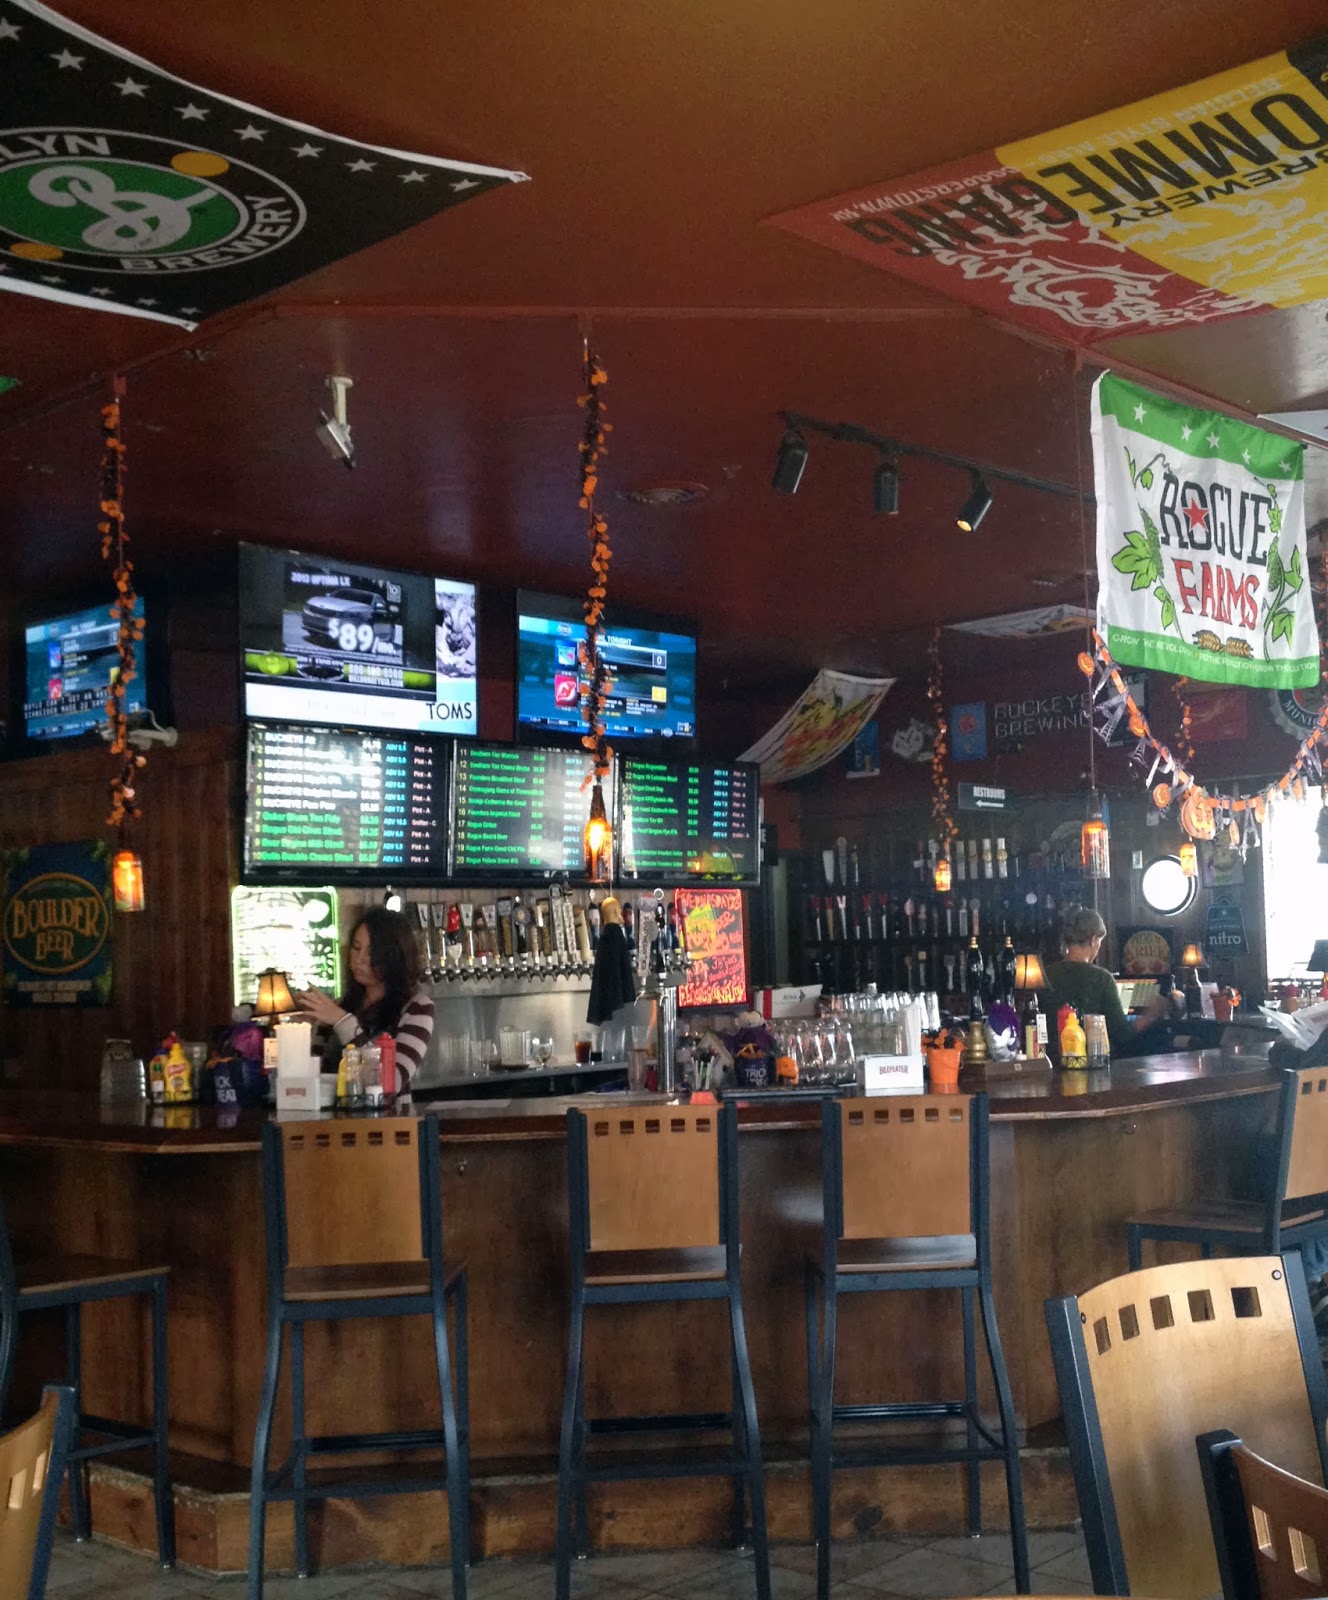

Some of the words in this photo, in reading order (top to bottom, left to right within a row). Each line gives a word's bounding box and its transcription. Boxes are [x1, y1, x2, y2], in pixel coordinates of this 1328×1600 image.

[120, 194, 298, 272] BREWERY
[1160, 473, 1274, 566] ROGUE
[1172, 558, 1260, 631] FARMS
[426, 702, 473, 721] TOMS
[994, 692, 1091, 719] BUCKEYE
[995, 710, 1091, 738] BREWING
[973, 786, 1005, 800] RESTROOMS
[13, 897, 99, 939] BOULDER
[35, 929, 75, 961] BEER
[1209, 931, 1241, 945] nitro
